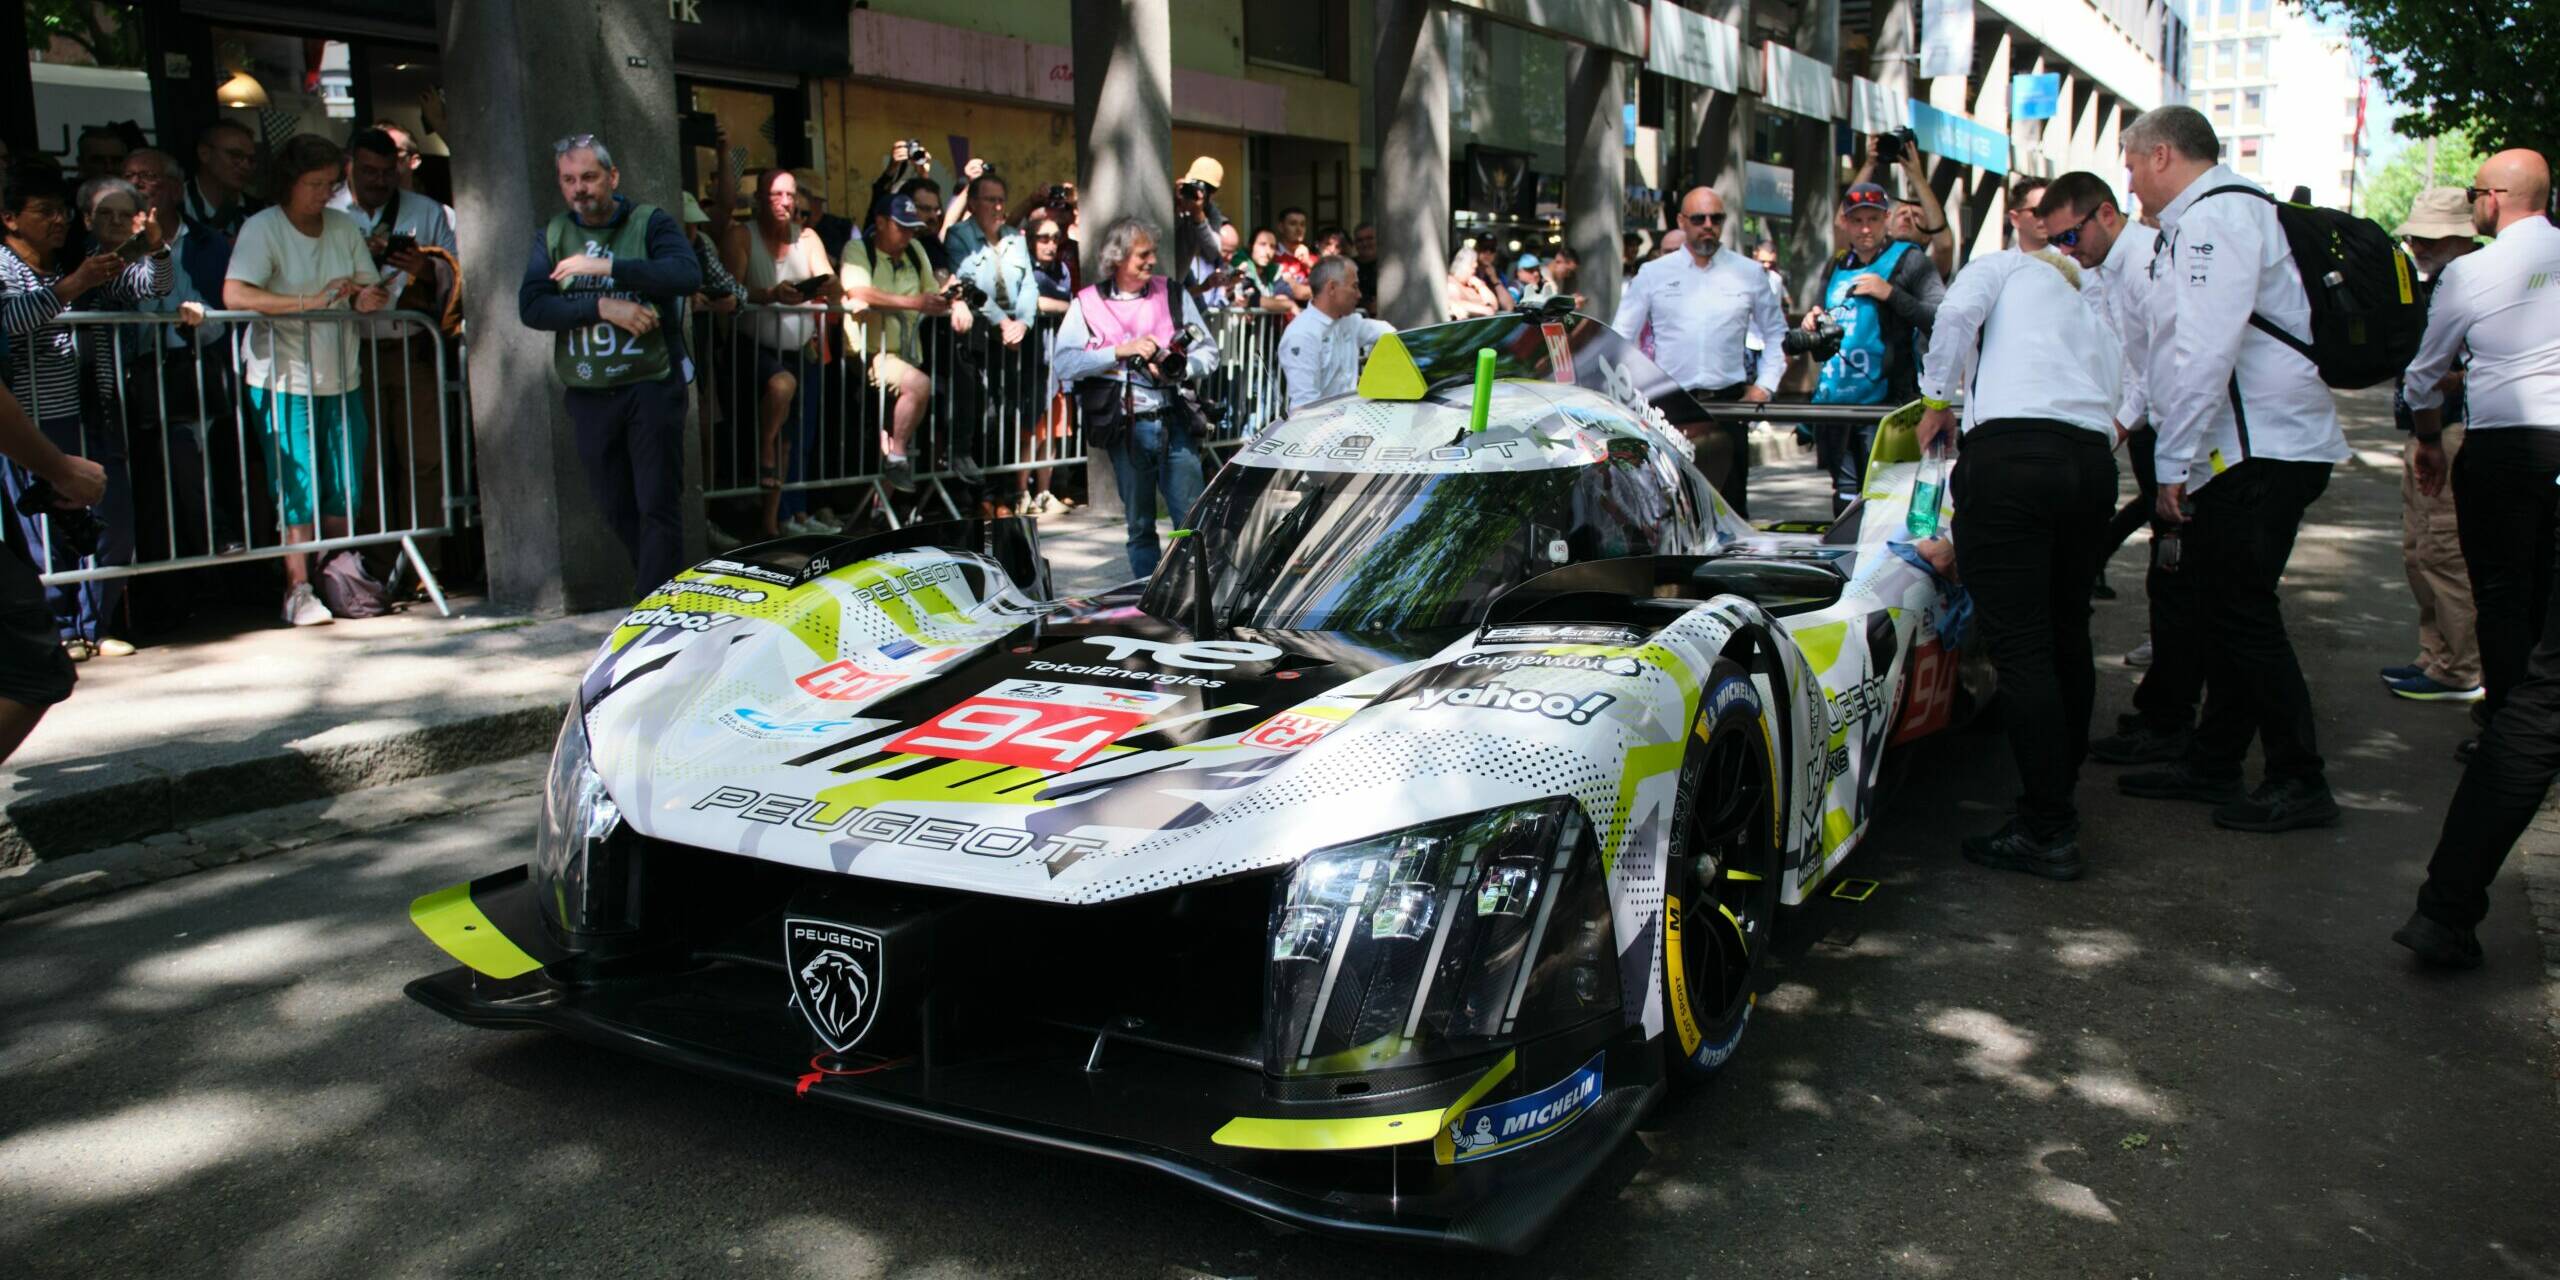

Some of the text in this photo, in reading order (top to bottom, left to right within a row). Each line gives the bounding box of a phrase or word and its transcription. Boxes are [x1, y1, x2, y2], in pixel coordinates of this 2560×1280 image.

[852, 561, 961, 612] PEUGEOT
[1025, 660, 1227, 689] TotalEnergies
[1456, 652, 1602, 671] Capgemini
[1410, 680, 1616, 725] yahoo!
[1716, 681, 1759, 715] MICHELIN
[1904, 651, 1957, 732] 94
[904, 704, 1115, 764] 94
[692, 785, 1109, 864] PEUGEOT
[795, 928, 876, 953] PEUGEOT
[1675, 975, 1688, 1016] SPORT
[1501, 1072, 1597, 1137] MICHELIN
